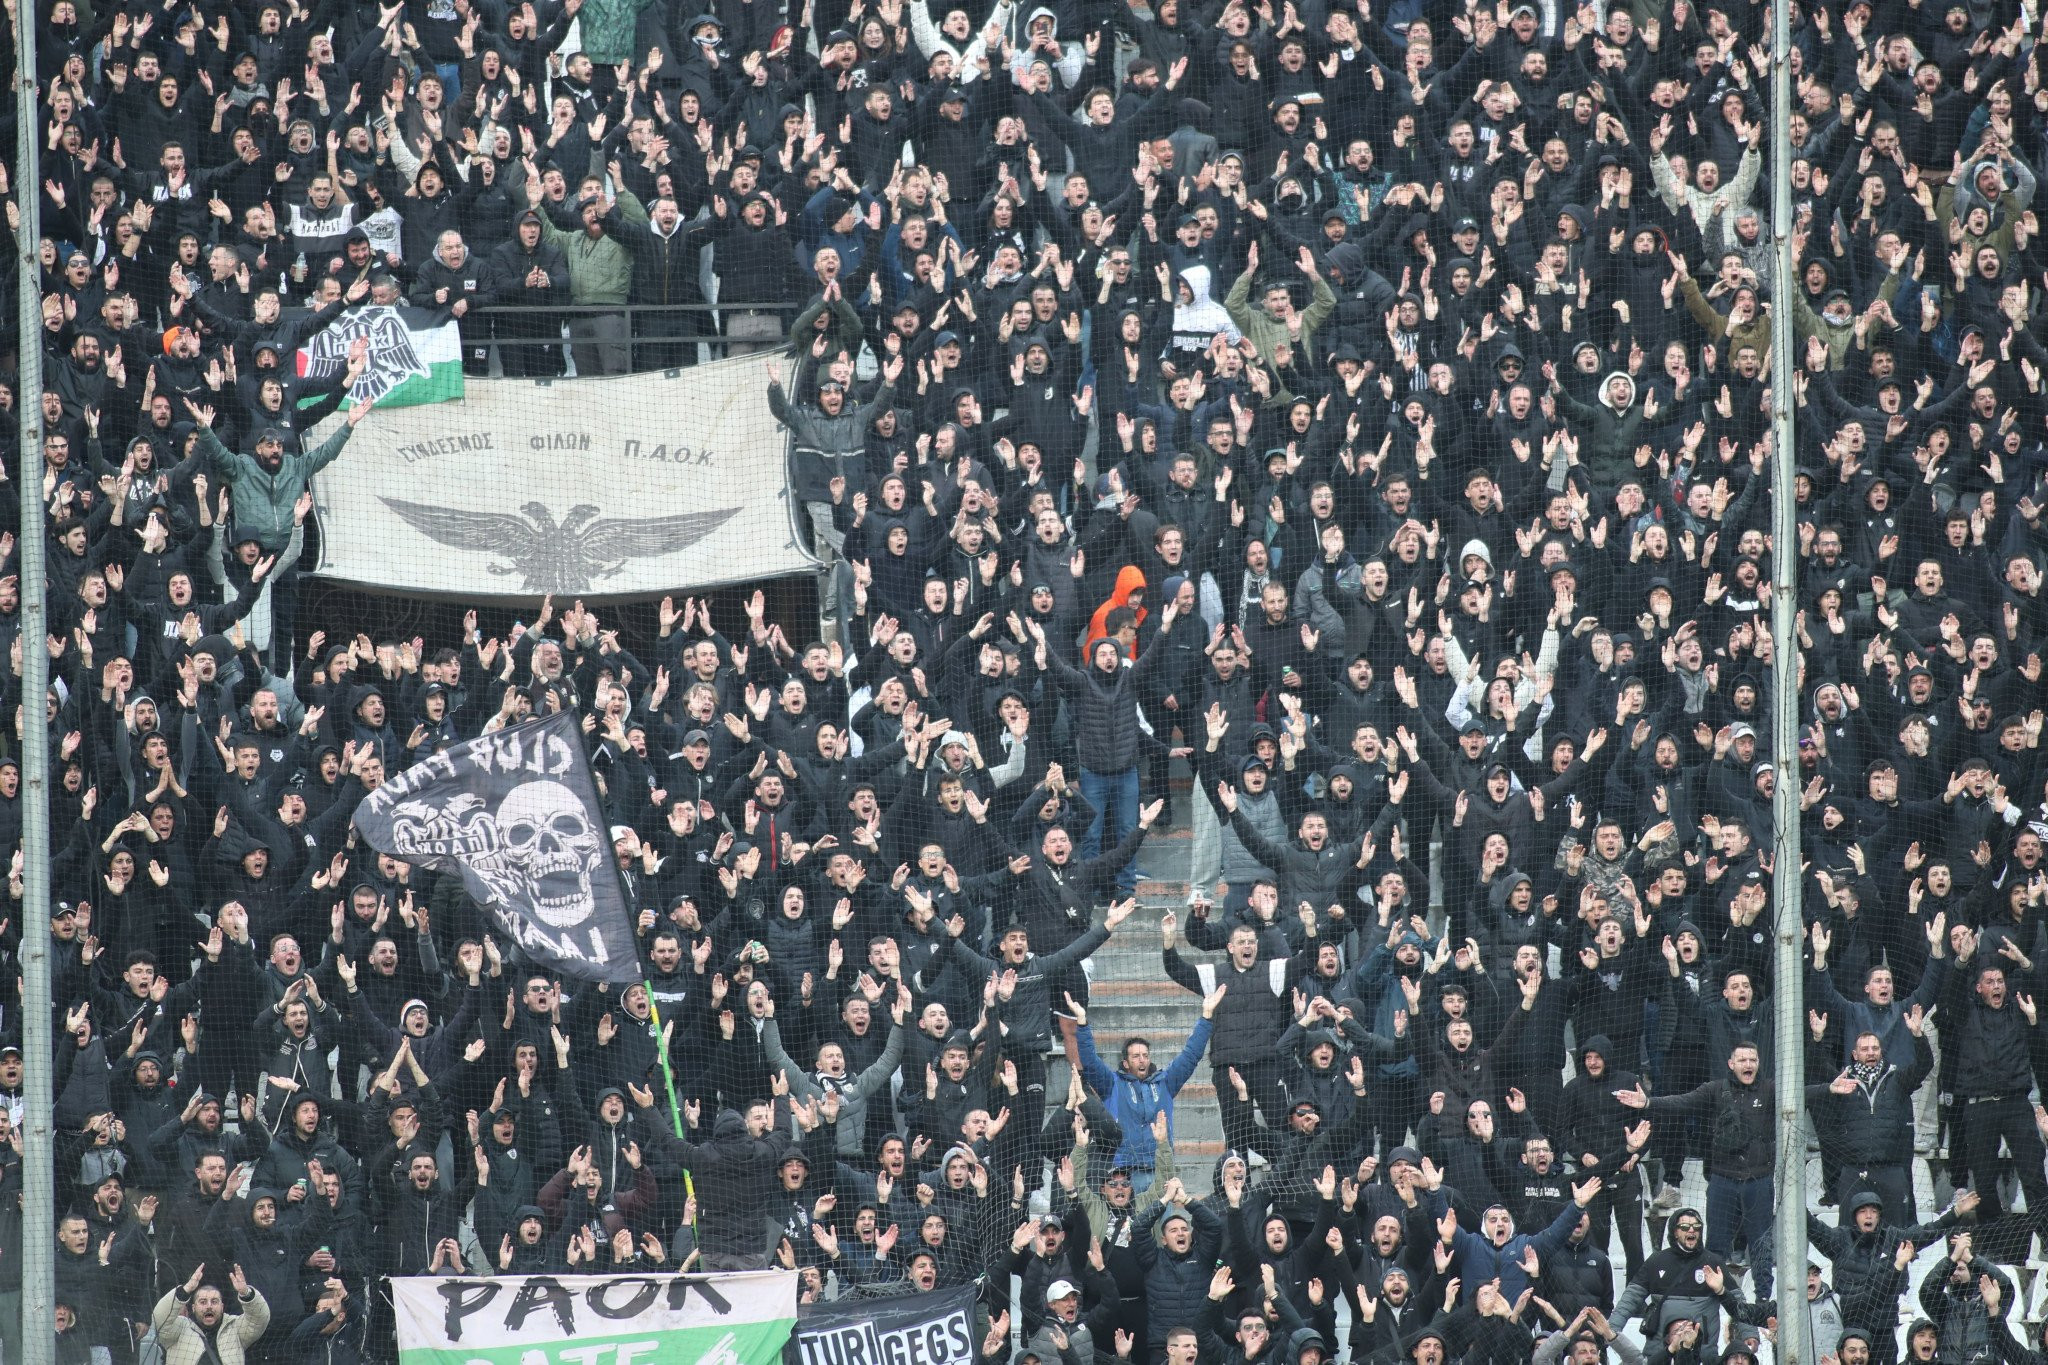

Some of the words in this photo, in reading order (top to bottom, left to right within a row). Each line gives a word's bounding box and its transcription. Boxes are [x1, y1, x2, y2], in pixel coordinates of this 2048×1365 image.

[398, 432, 494, 463] ΣΥΝΔΕΣΜΟΣ
[530, 433, 591, 451] ΦΙΛΩΝ
[624, 439, 715, 466] Π.Α.Ο.Κ.
[437, 1276, 732, 1342] PAOK
[800, 1325, 881, 1365] TURI
[883, 1315, 972, 1365] GEGS
